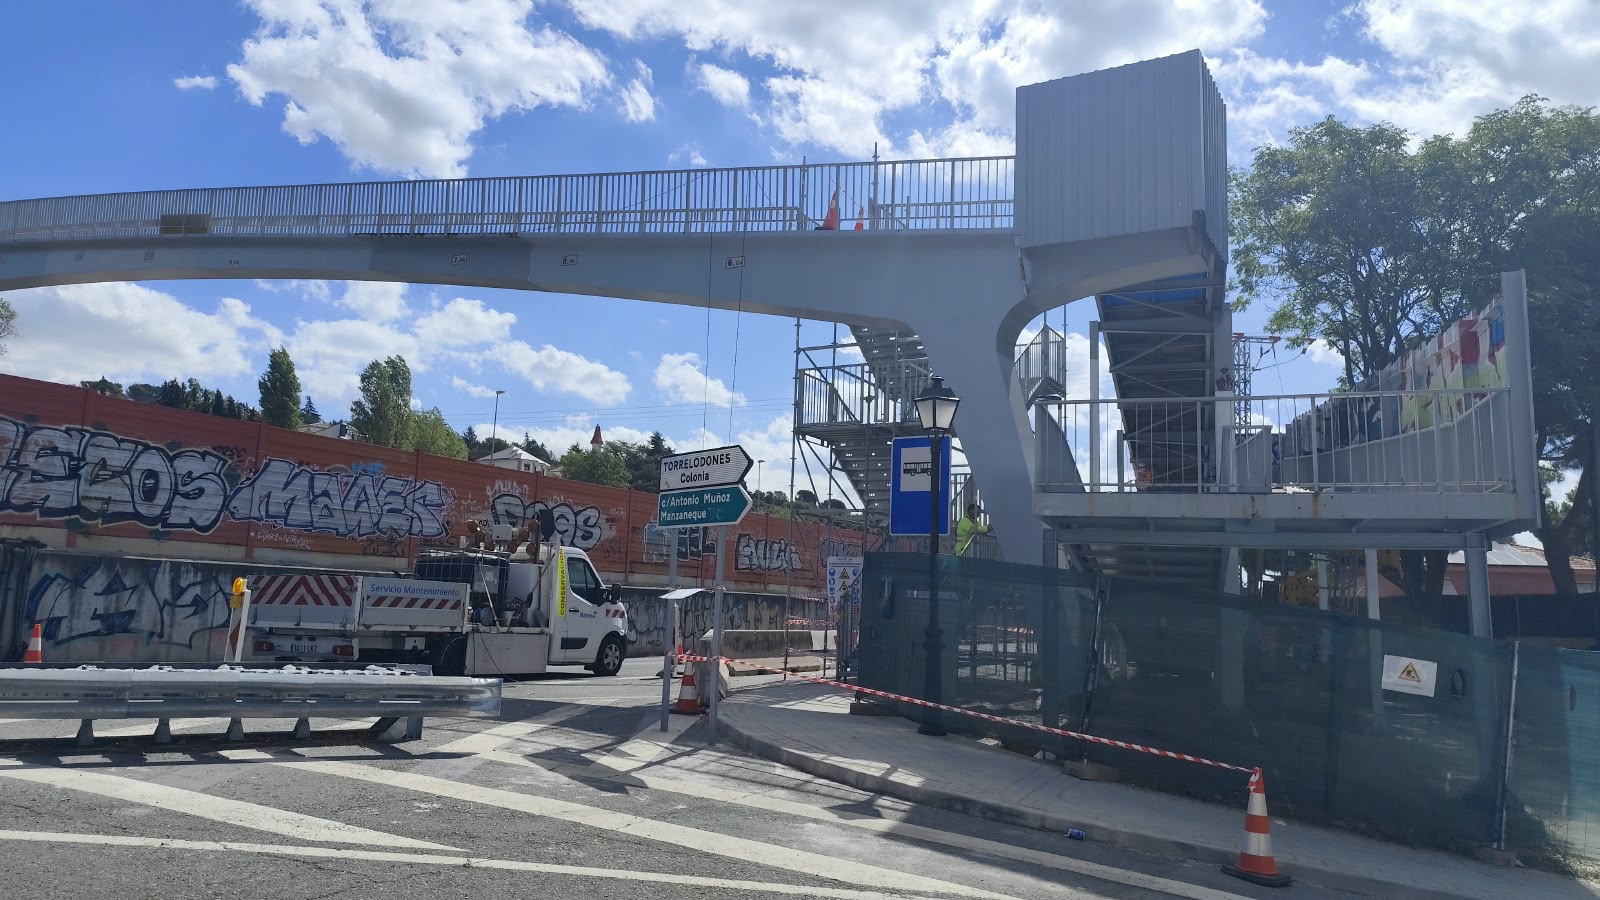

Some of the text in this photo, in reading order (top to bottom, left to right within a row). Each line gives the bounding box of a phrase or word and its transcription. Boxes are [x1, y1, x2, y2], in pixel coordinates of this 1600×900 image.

[663, 453, 731, 472] TORRELODONES
[680, 471, 710, 483] Colonia
[661, 491, 731, 508] c/Antonio Muñoz
[660, 510, 707, 522] Manzaneque
[370, 584, 460, 596] Servicio Mantenimiento
